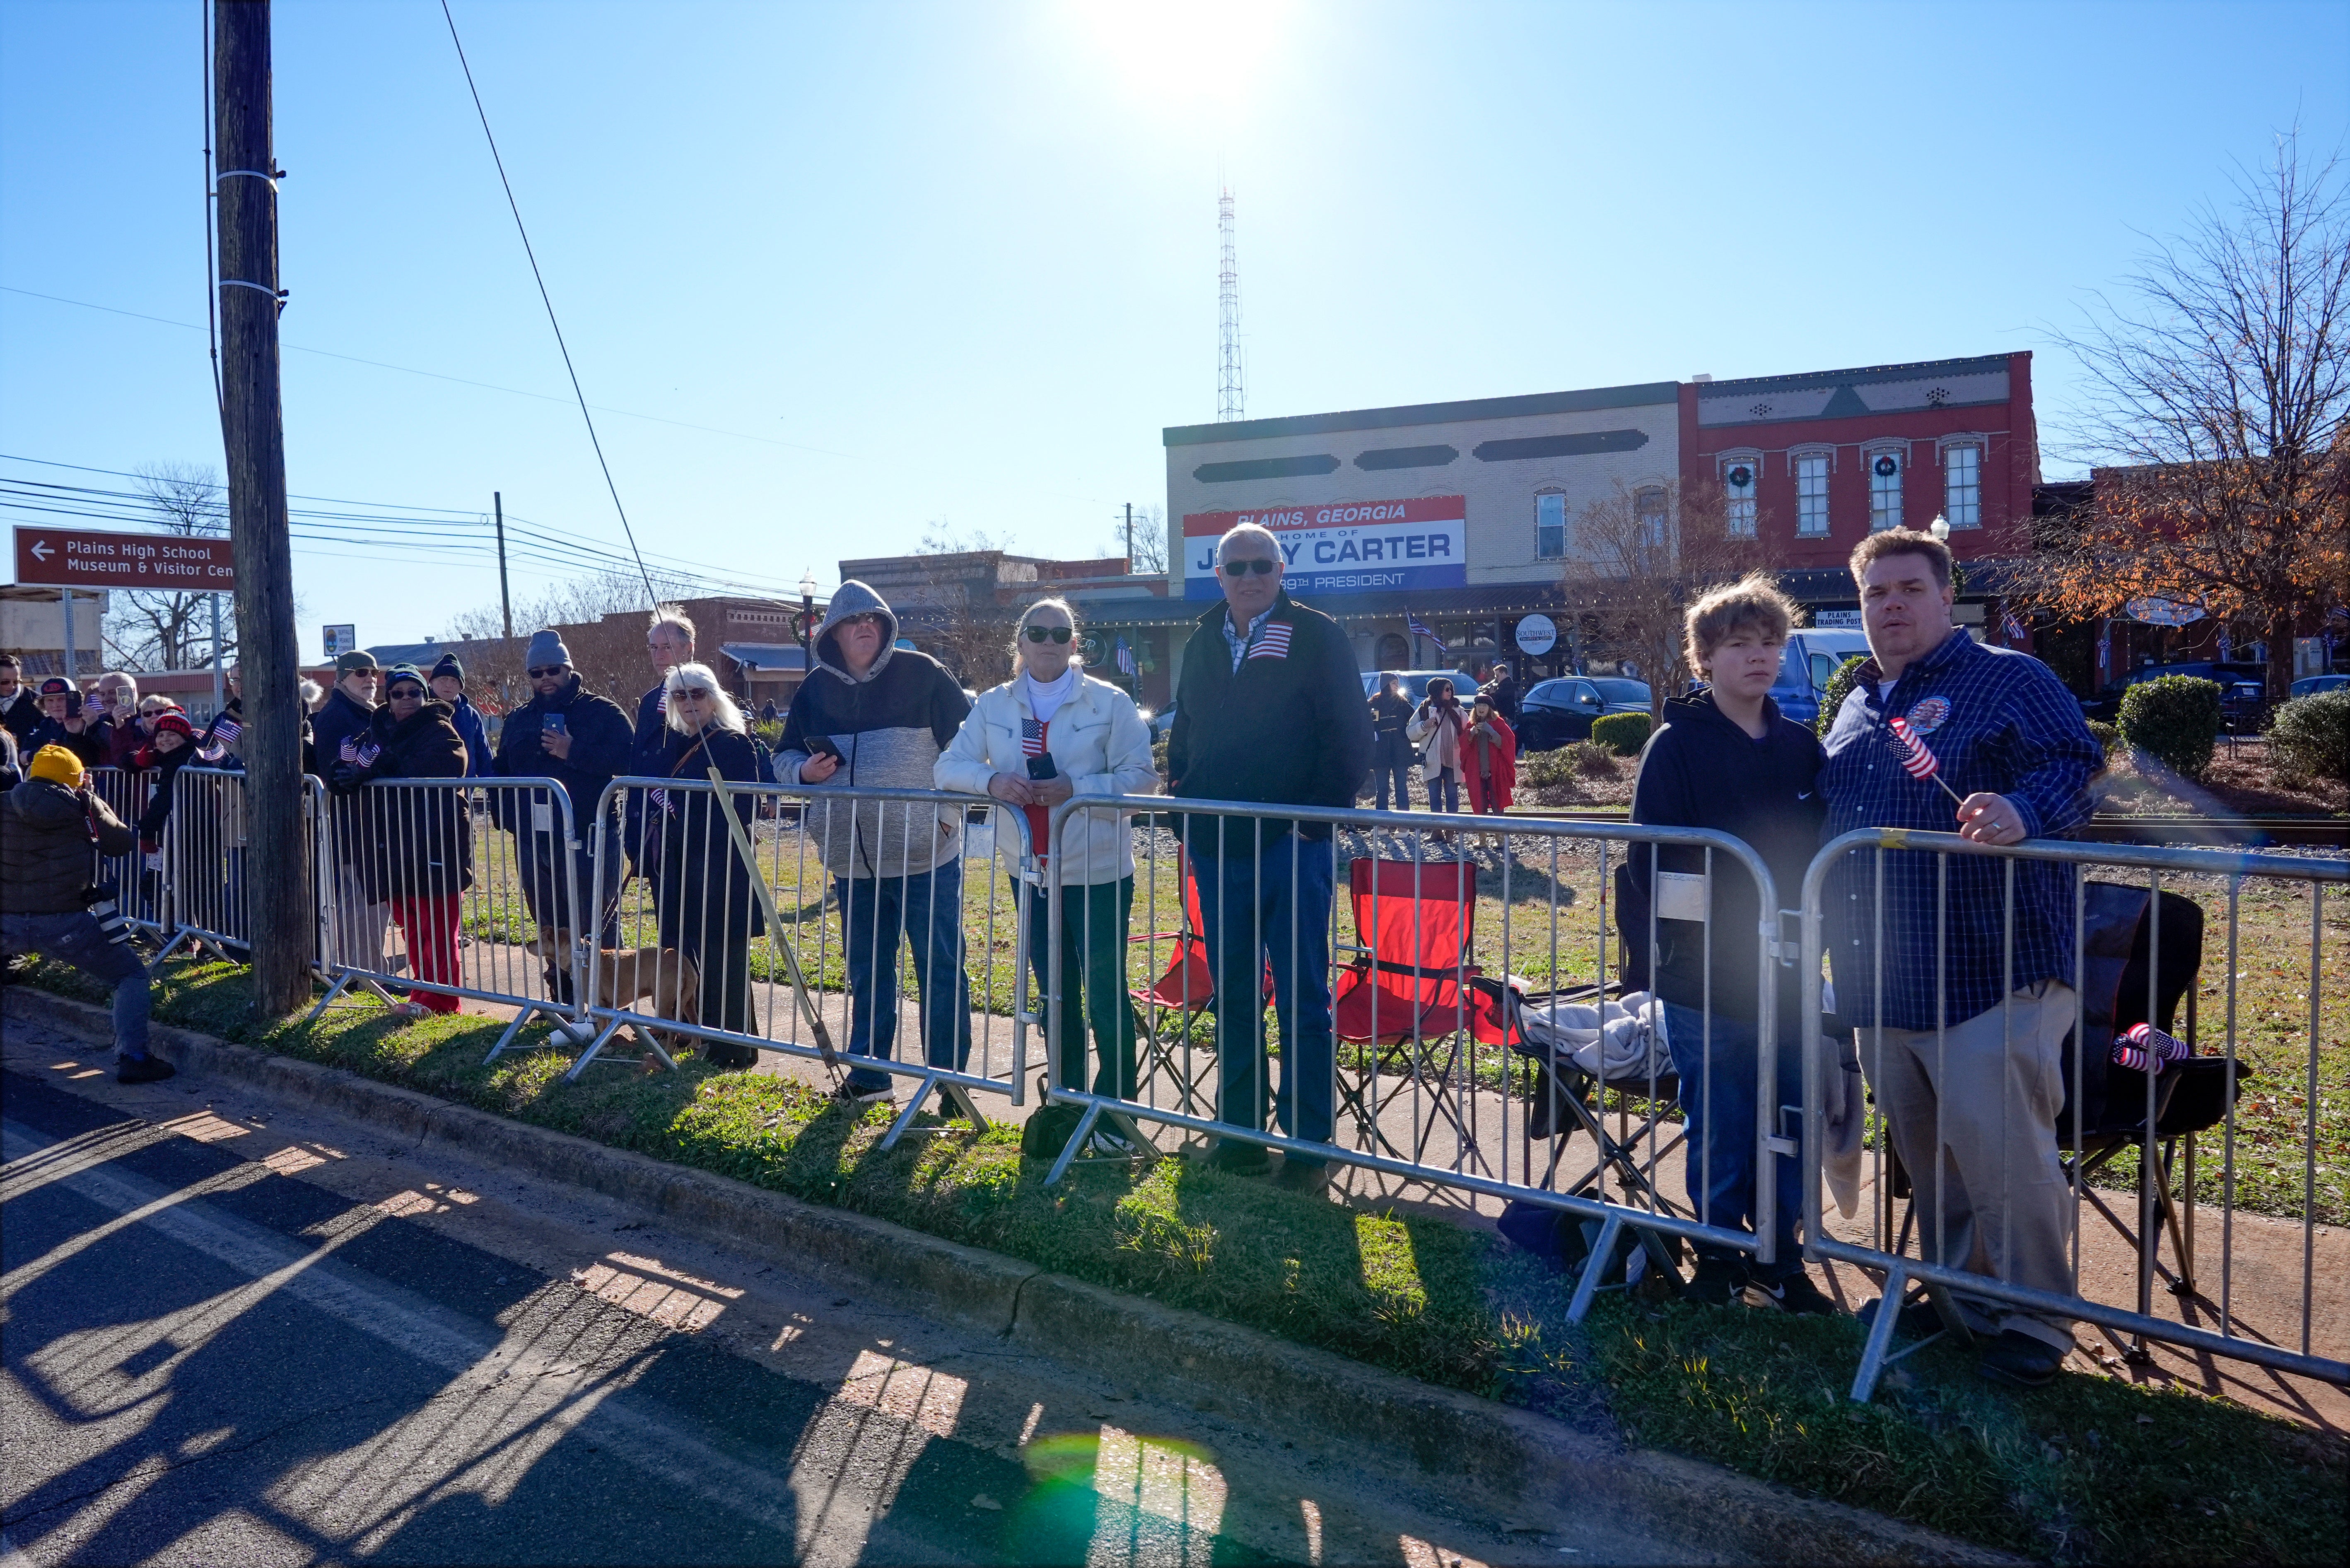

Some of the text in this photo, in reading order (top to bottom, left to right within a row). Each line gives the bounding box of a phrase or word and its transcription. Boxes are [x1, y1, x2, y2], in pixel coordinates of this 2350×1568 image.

[1316, 504, 1406, 523] GEORGIA
[1281, 532, 1327, 540] HOME
[67, 541, 211, 560] Plains High School
[1314, 534, 1450, 564] CARTER
[68, 559, 233, 577] Museum & Visitor Cen
[1315, 573, 1405, 588] PRESIDENT
[84, 816, 94, 833] Canon
